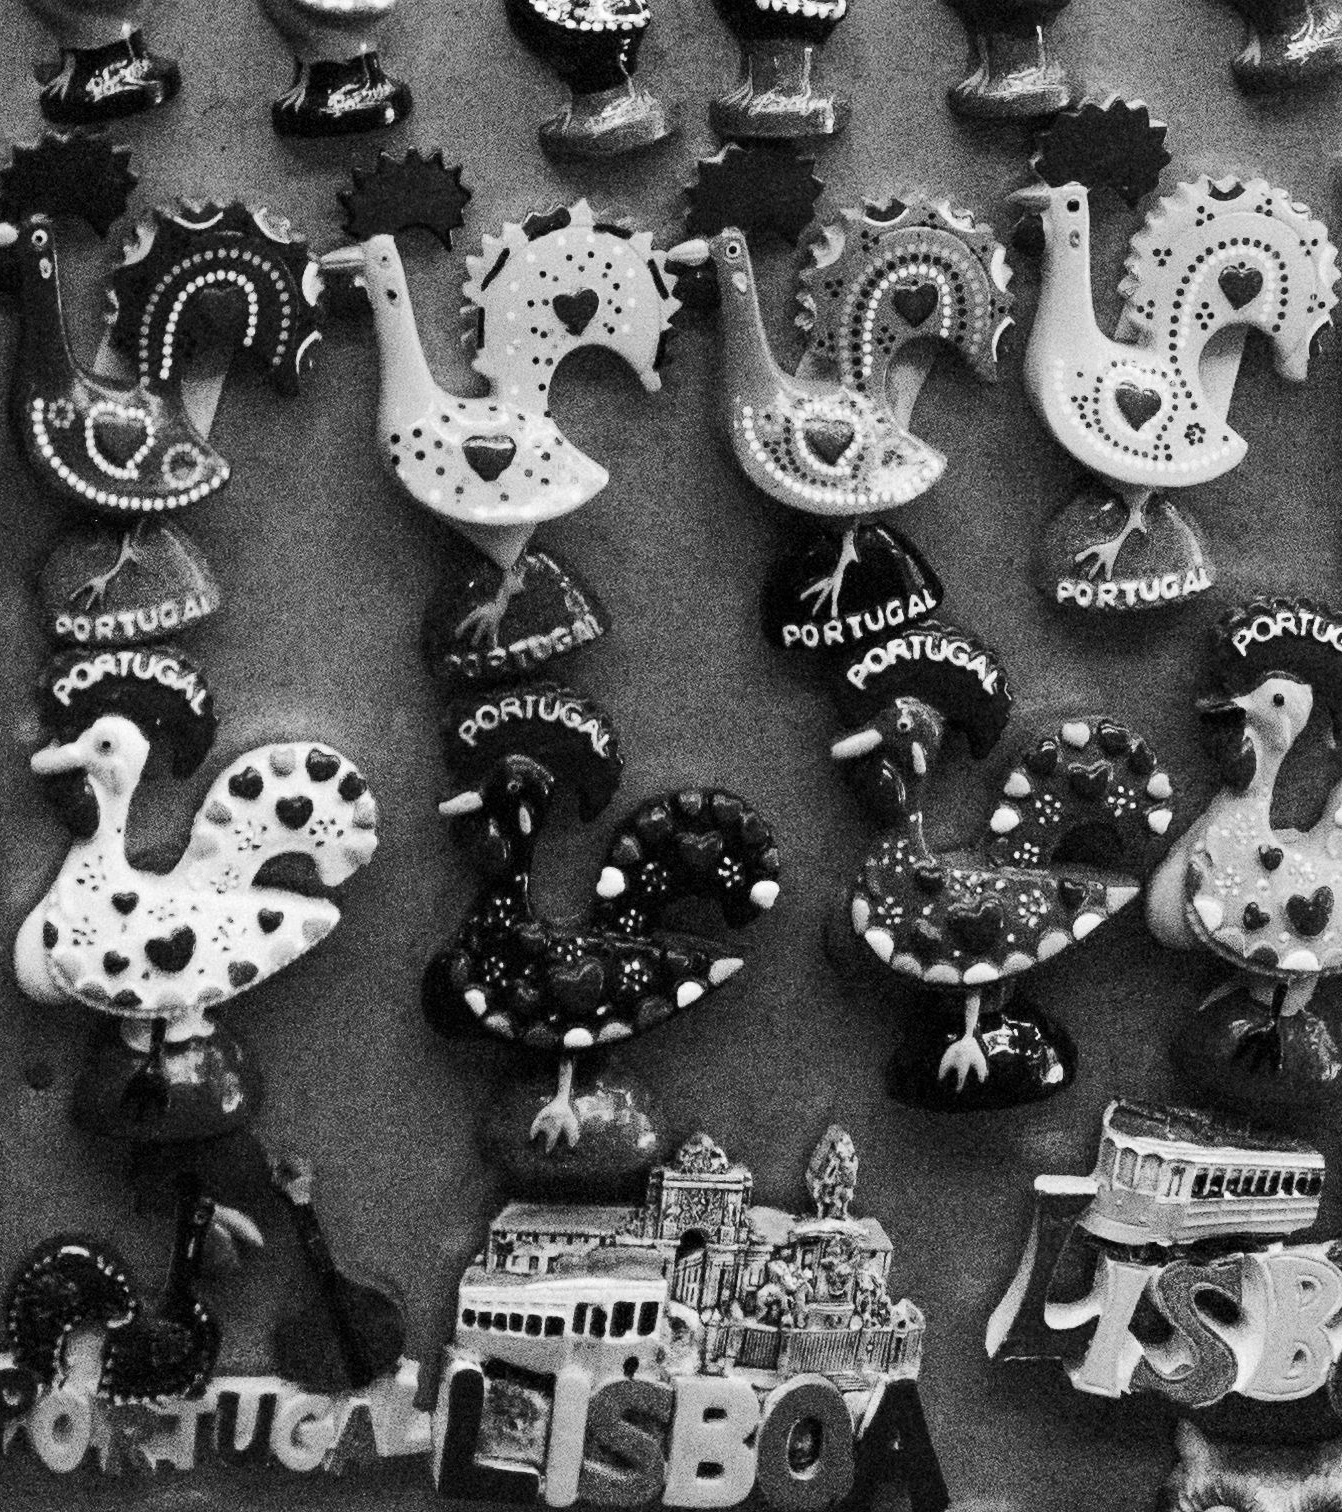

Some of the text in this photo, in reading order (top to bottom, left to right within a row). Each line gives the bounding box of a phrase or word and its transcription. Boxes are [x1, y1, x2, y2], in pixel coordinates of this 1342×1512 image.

[55, 595, 217, 641] PORTUGAL
[782, 587, 938, 649] PORTUGAL
[1055, 568, 1213, 608] PORTUGAL
[51, 652, 208, 716] PORTUGAL
[846, 634, 999, 694] PORTUGAL
[457, 693, 613, 755] PORTUGAL
